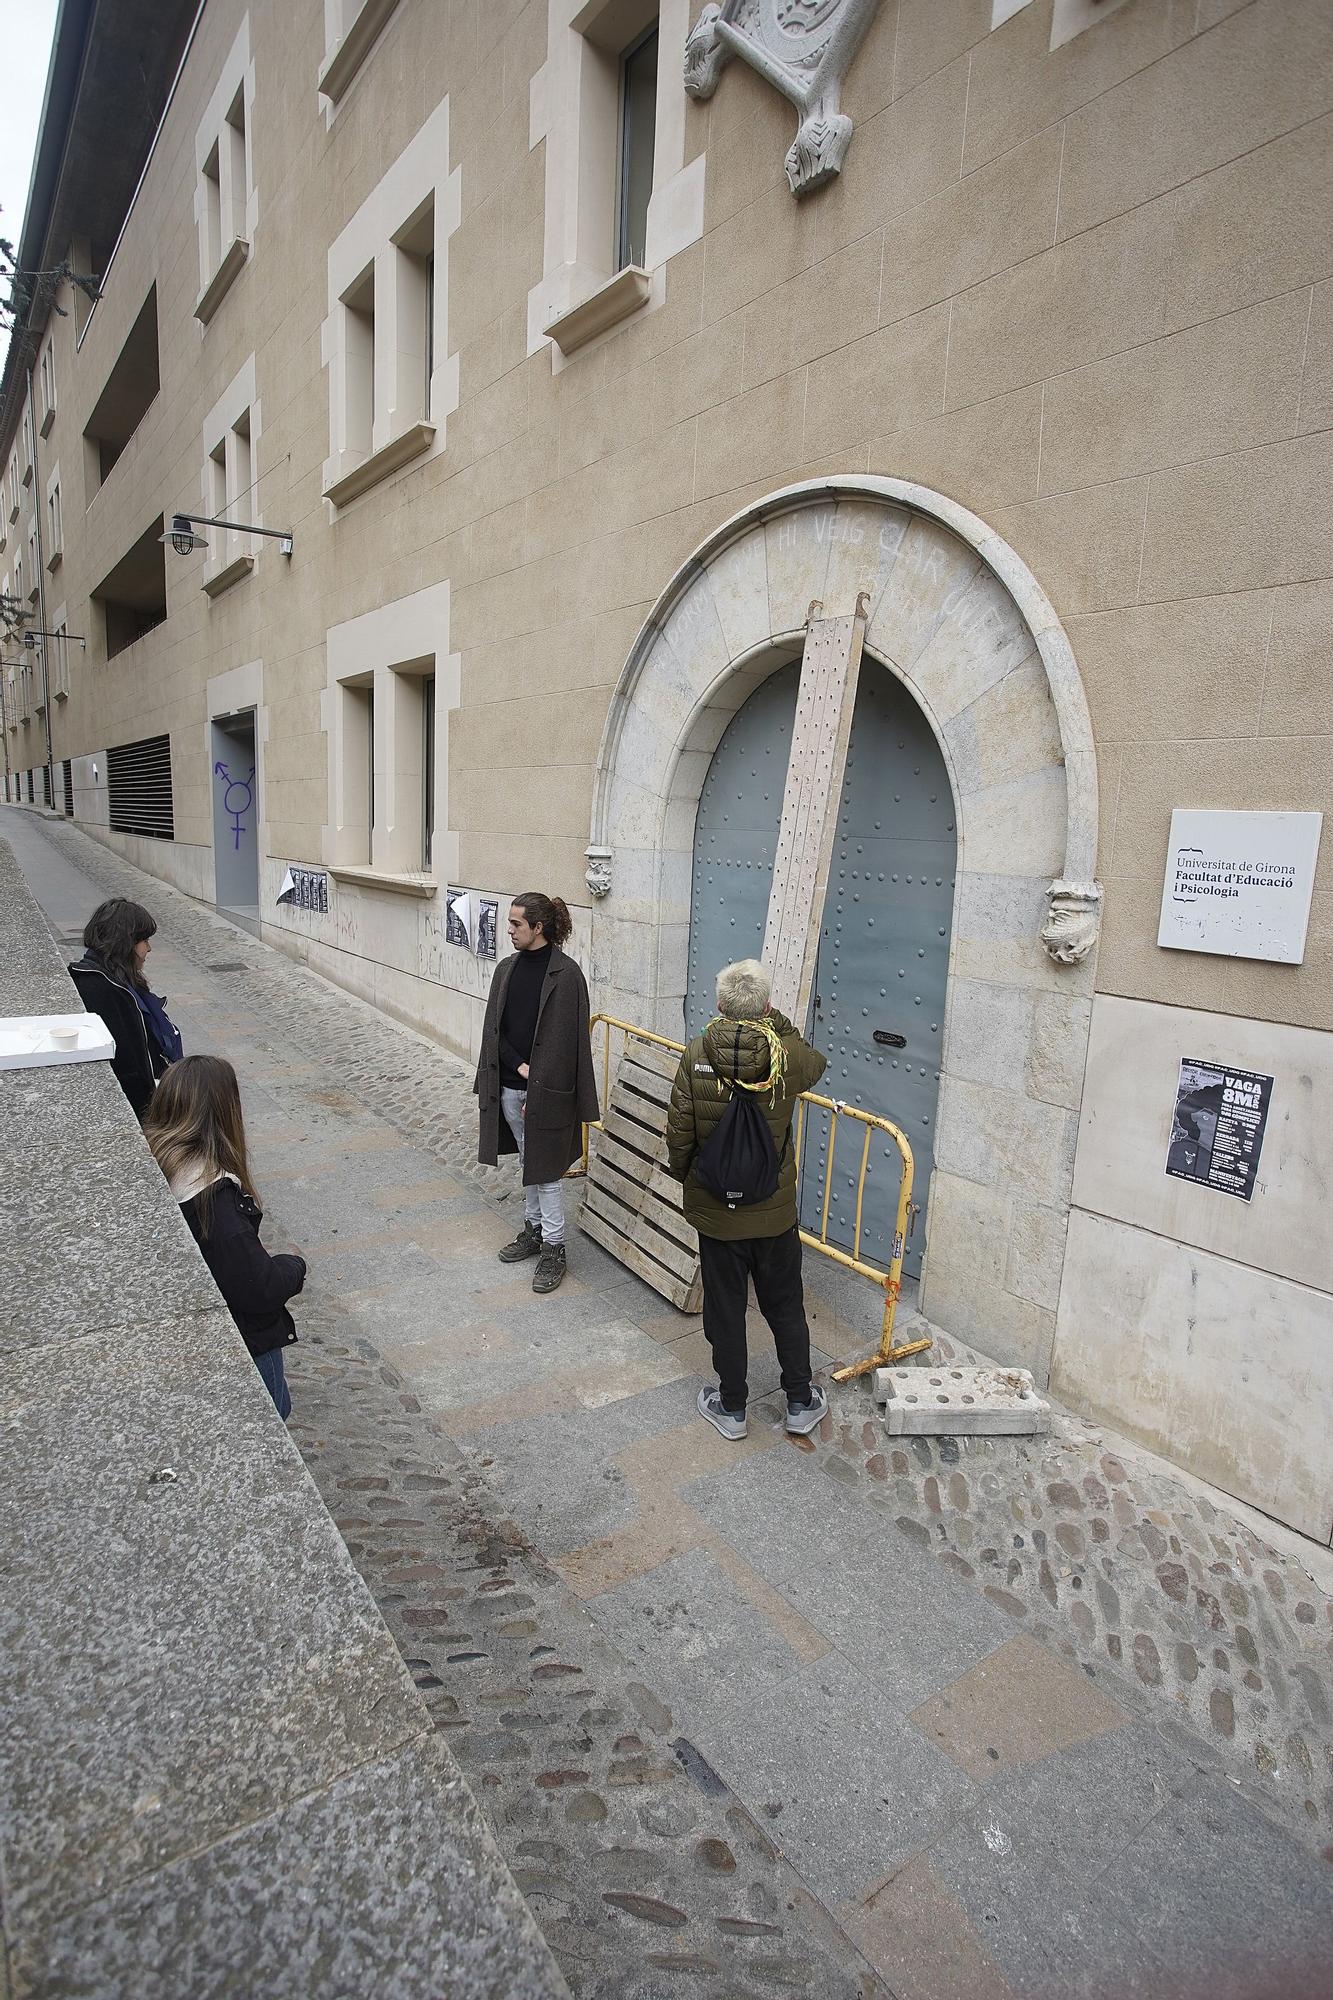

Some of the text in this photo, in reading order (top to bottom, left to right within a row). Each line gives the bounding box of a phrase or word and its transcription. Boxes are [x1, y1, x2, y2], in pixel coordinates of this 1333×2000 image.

[1177, 858, 1296, 875] Universitat de Girona
[1176, 870, 1222, 883] Facultat
[1180, 883, 1239, 898] Psicologia
[1225, 1076, 1262, 1095] VAGA
[1222, 1088, 1254, 1108] 8M
